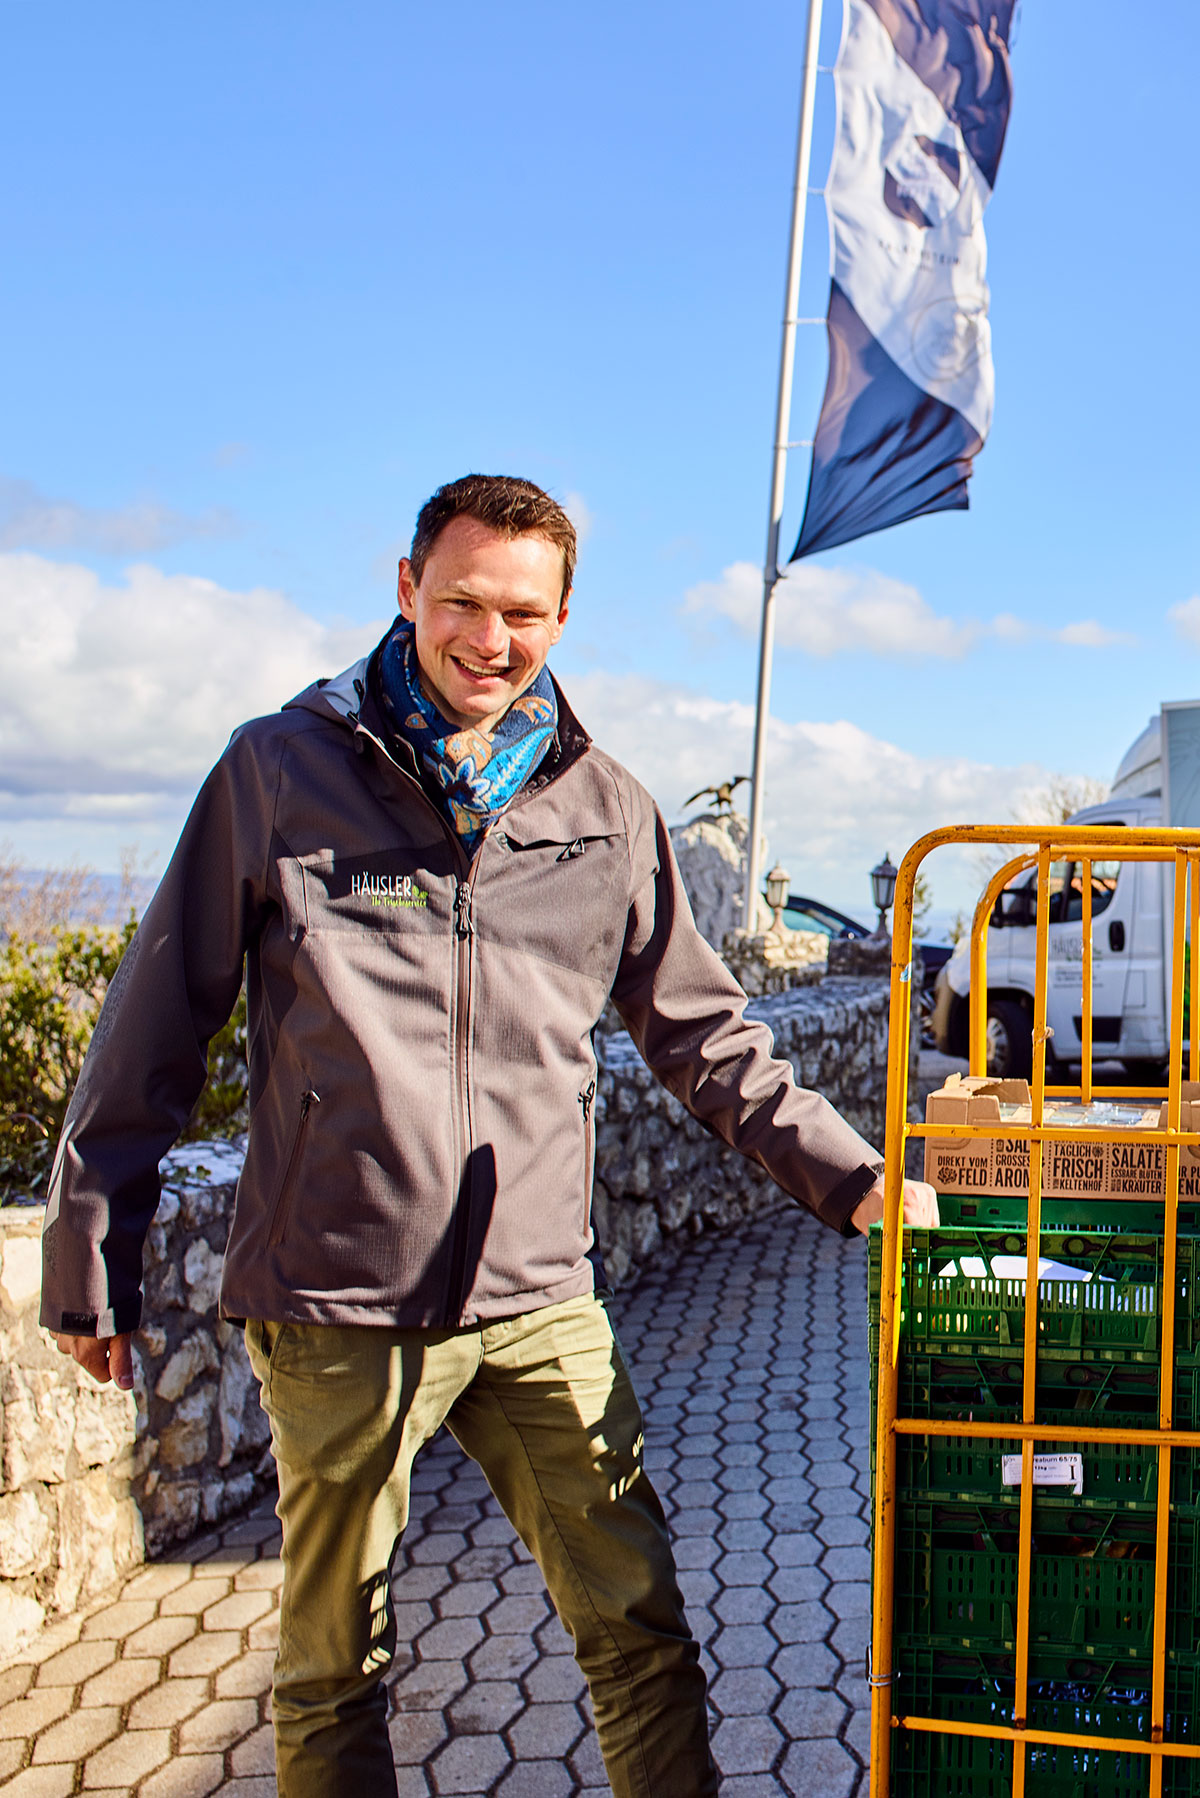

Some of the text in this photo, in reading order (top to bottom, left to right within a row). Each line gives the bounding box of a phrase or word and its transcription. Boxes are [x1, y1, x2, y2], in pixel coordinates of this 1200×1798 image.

[351, 871, 412, 896] HÄUSLER
[1054, 1144, 1092, 1158] TÄGLICH
[1111, 1147, 1163, 1169] SALATE
[937, 1155, 988, 1168] DIREKT VOM
[1053, 1158, 1104, 1179] FRISCH
[958, 1168, 988, 1187] FELD
[994, 1167, 1045, 1189] AROM
[1060, 1179, 1103, 1192] KELTENHOF
[1122, 1179, 1162, 1194] KRÄUTER
